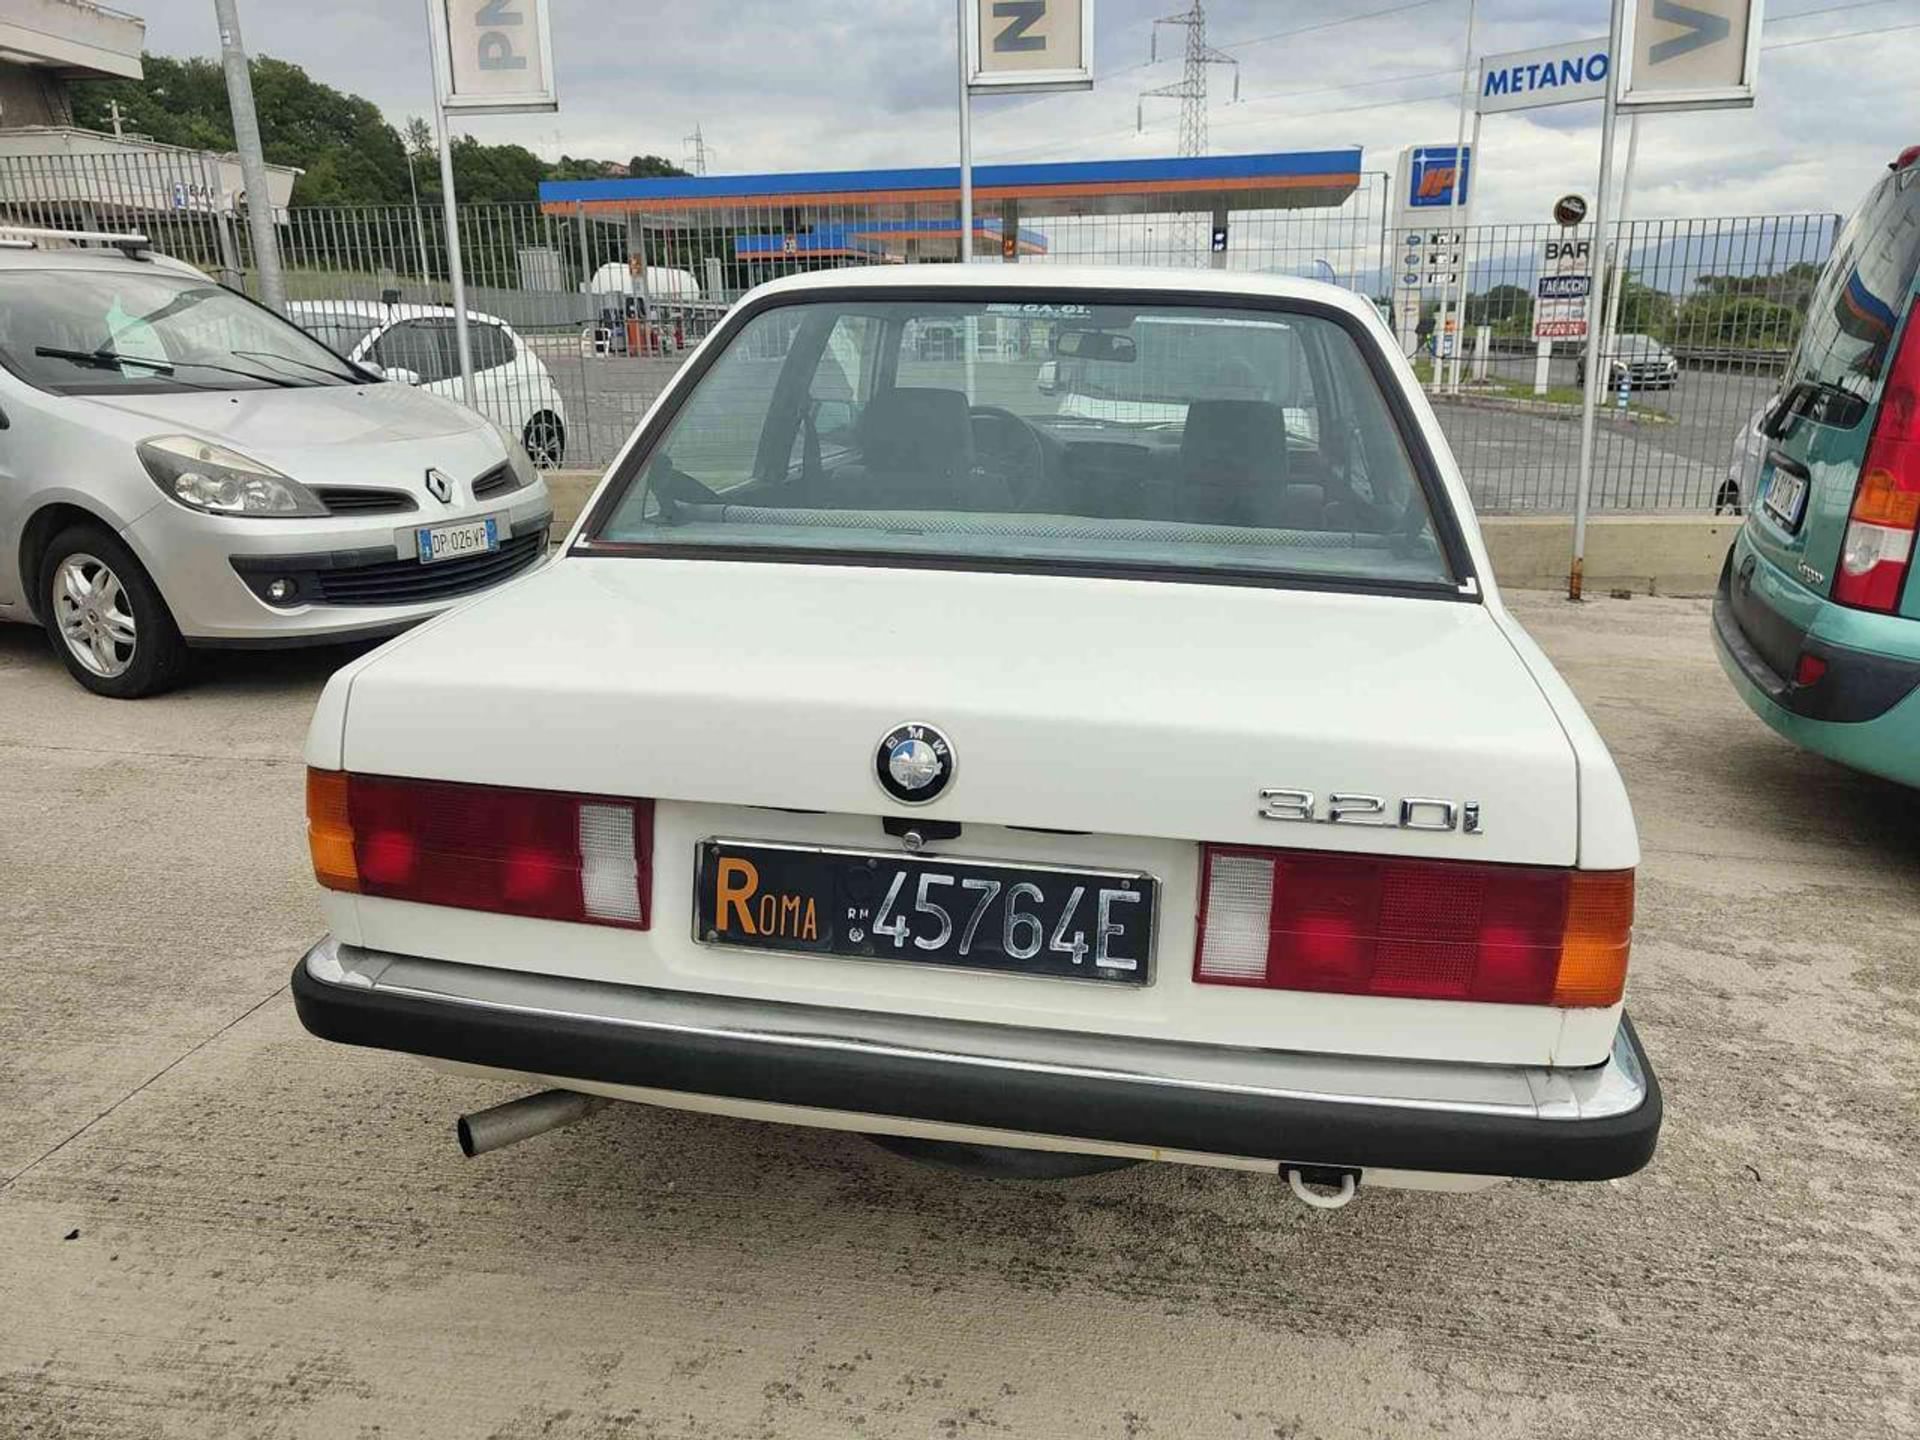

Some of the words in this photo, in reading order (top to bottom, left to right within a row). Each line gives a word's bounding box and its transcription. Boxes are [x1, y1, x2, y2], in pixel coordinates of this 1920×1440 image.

[1484, 53, 1608, 97] METANO
[1545, 242, 1590, 259] BAR
[886, 727, 948, 756] BMW
[847, 907, 869, 920] RM
[872, 871, 1141, 969] 45764E
